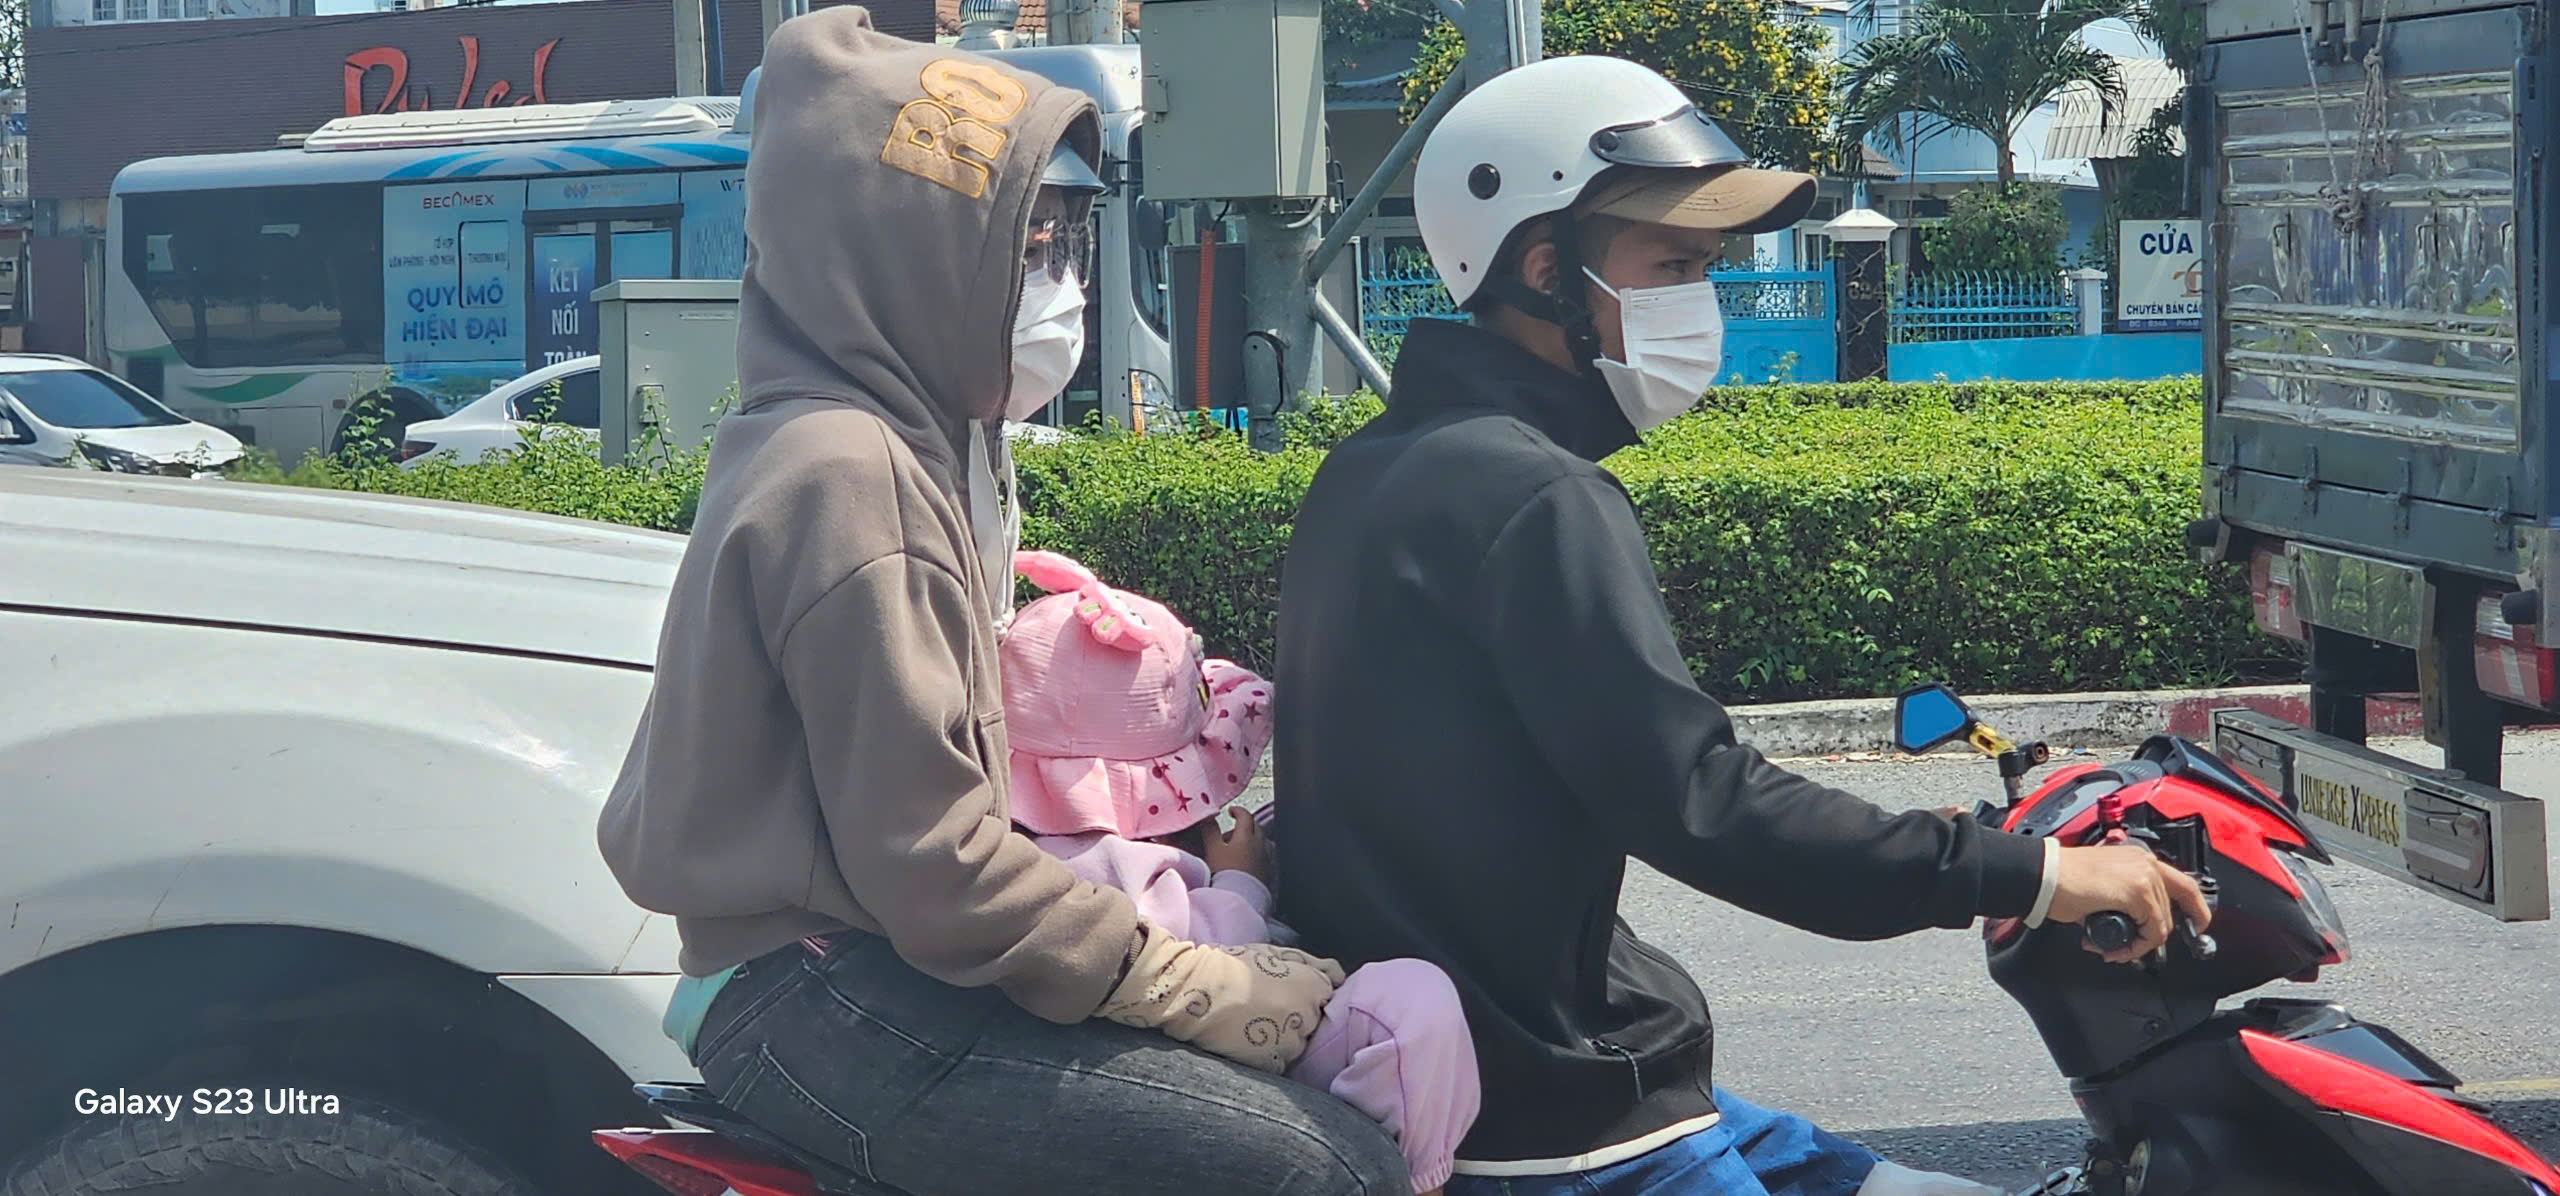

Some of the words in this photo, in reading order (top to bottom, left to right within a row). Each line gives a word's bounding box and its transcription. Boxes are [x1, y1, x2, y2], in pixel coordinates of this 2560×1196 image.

[880, 58, 1027, 199] RO
[423, 191, 495, 210] BECAMEX
[2140, 222, 2194, 256] CỬA
[407, 284, 456, 313] QUY
[466, 277, 504, 306] MÔ
[402, 313, 457, 346] HIỆN
[465, 317, 508, 345] ĐẠI
[551, 300, 579, 335] NỐI
